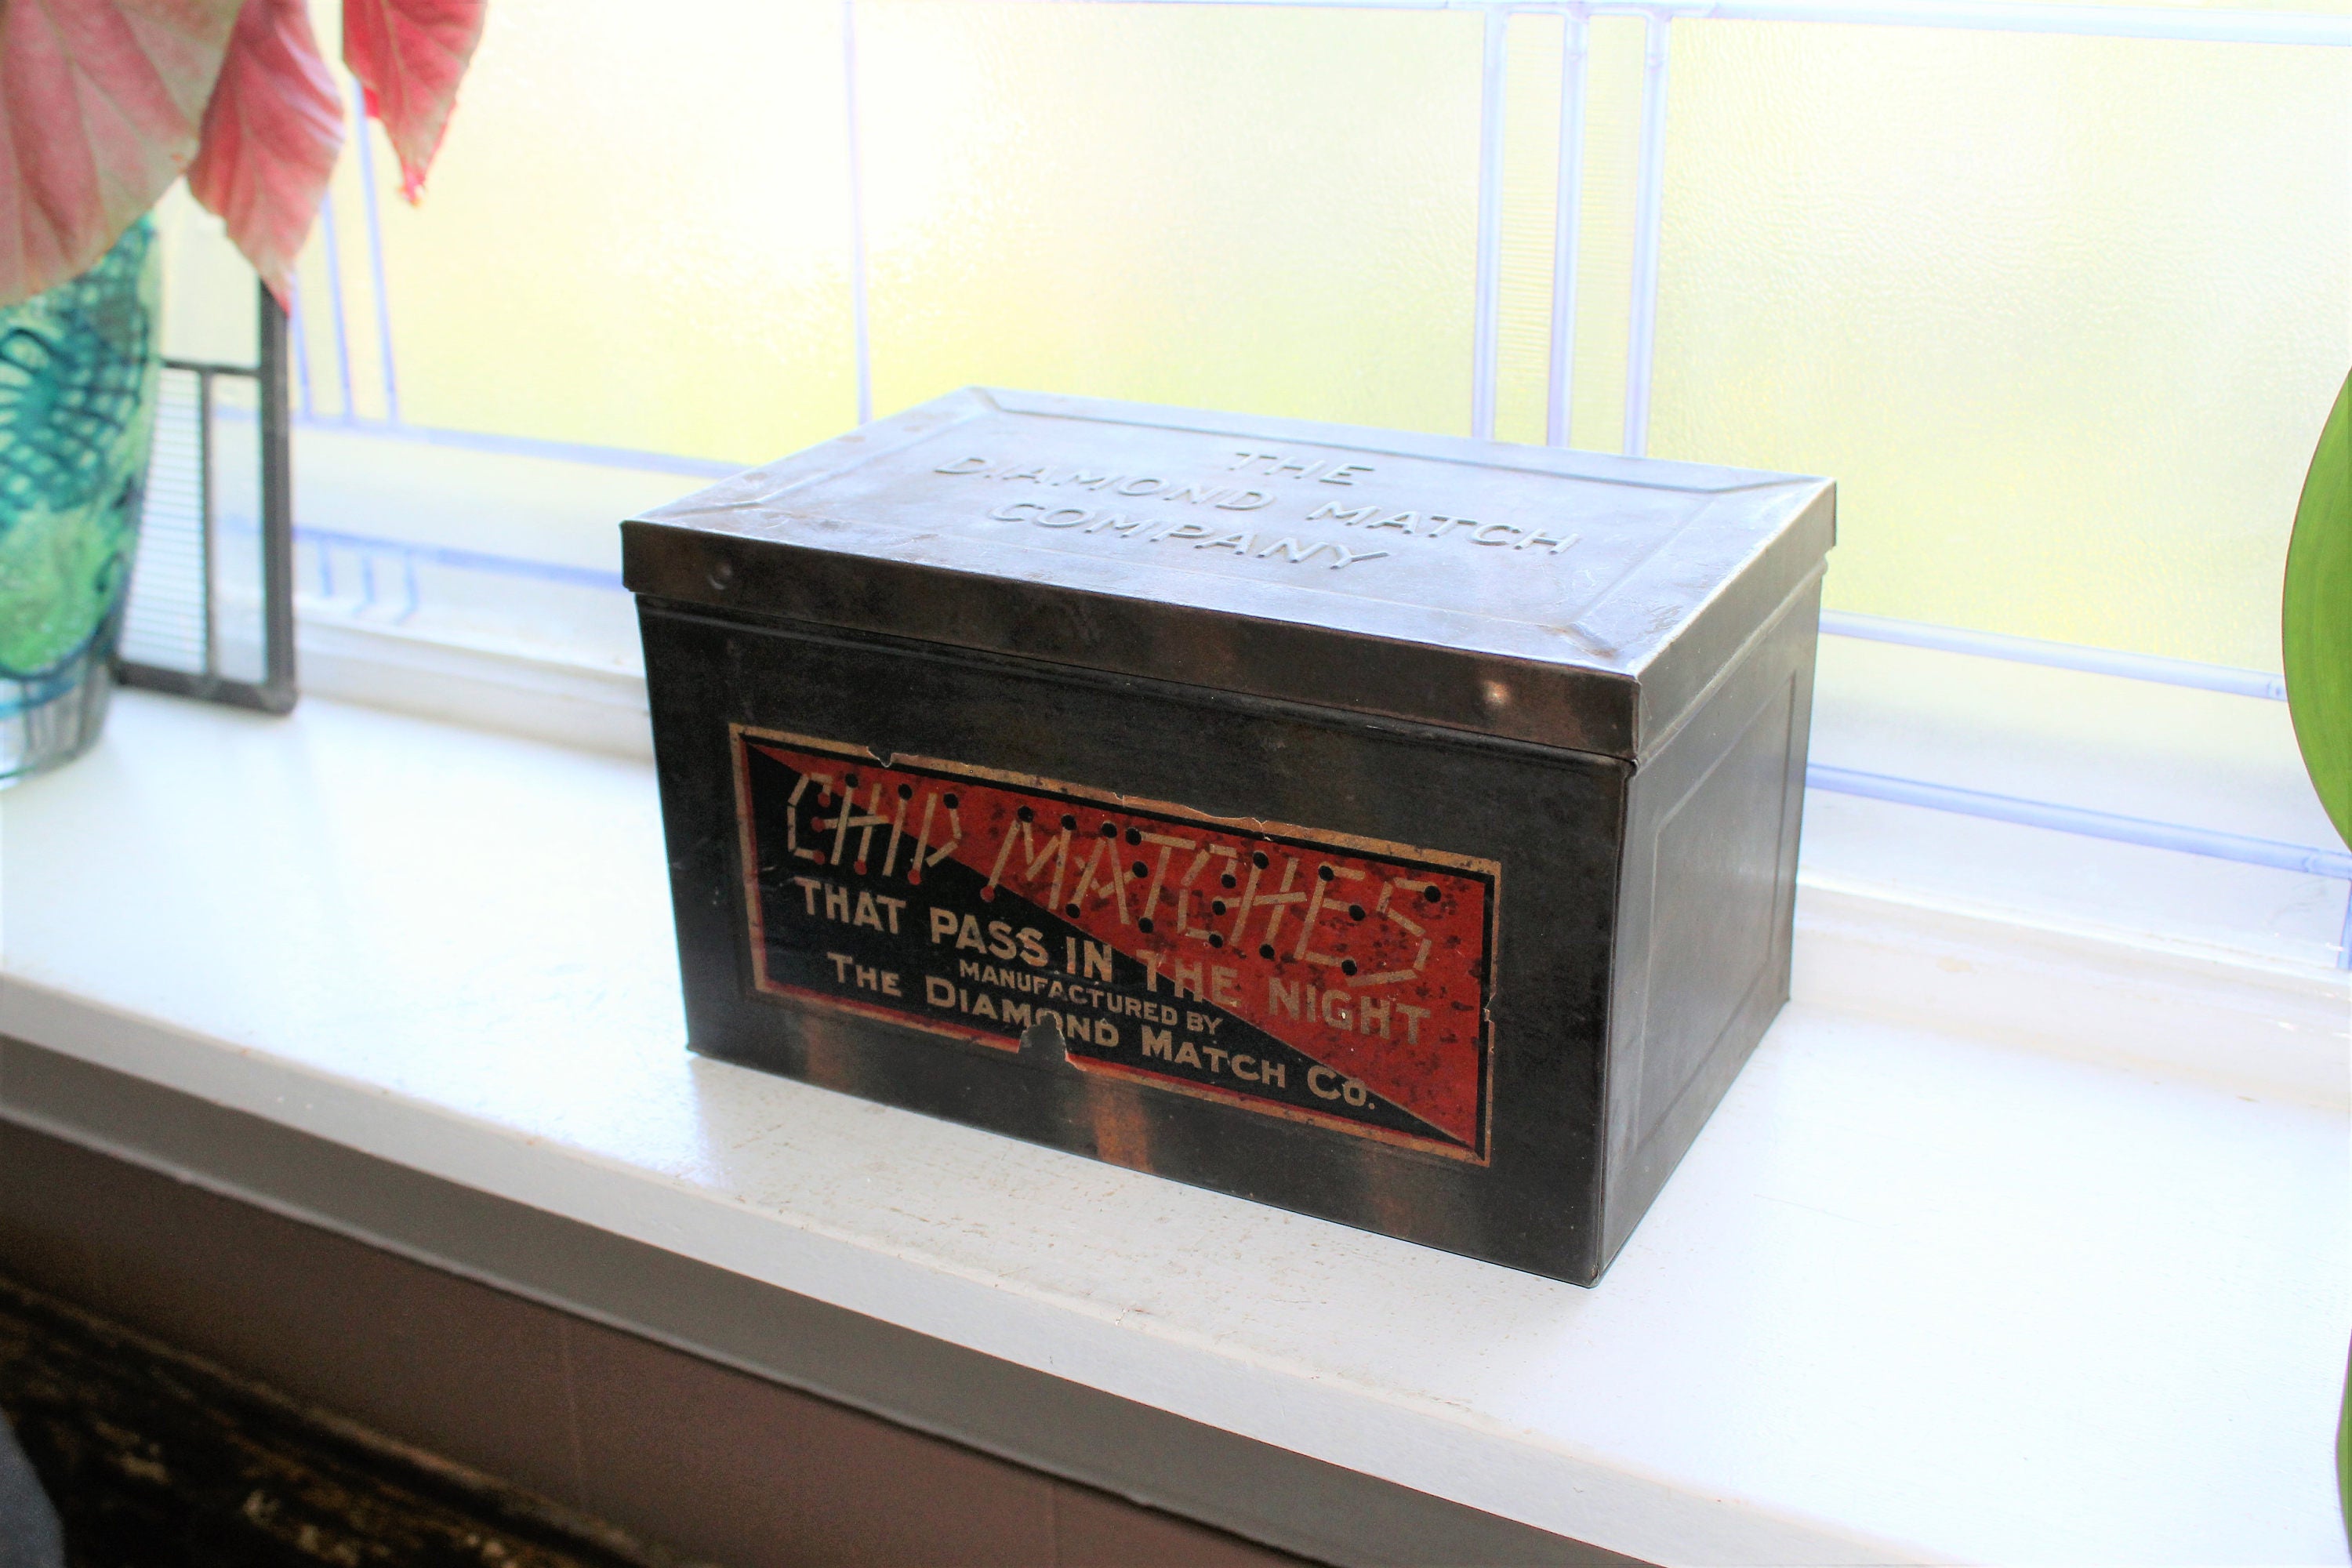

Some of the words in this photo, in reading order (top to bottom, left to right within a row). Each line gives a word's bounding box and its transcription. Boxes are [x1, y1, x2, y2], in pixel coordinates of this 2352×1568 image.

[934, 456, 1276, 511] DIAMOND
[1305, 499, 1581, 555] MATCH
[1227, 452, 1375, 485] THE
[989, 502, 1389, 570] COMPANY
[786, 772, 962, 885] CHIP
[980, 805, 1442, 989] MATCHES
[793, 876, 907, 935] THAT
[929, 906, 1049, 967] PASS
[1065, 936, 1113, 983] IN
[1136, 950, 1242, 1007] THE
[1267, 977, 1432, 1045] NIGHT
[959, 959, 1178, 1027] MANUFACTURED
[1185, 1011, 1224, 1036] BY
[826, 952, 902, 998] THE
[1142, 1025, 1287, 1088] MATCH
